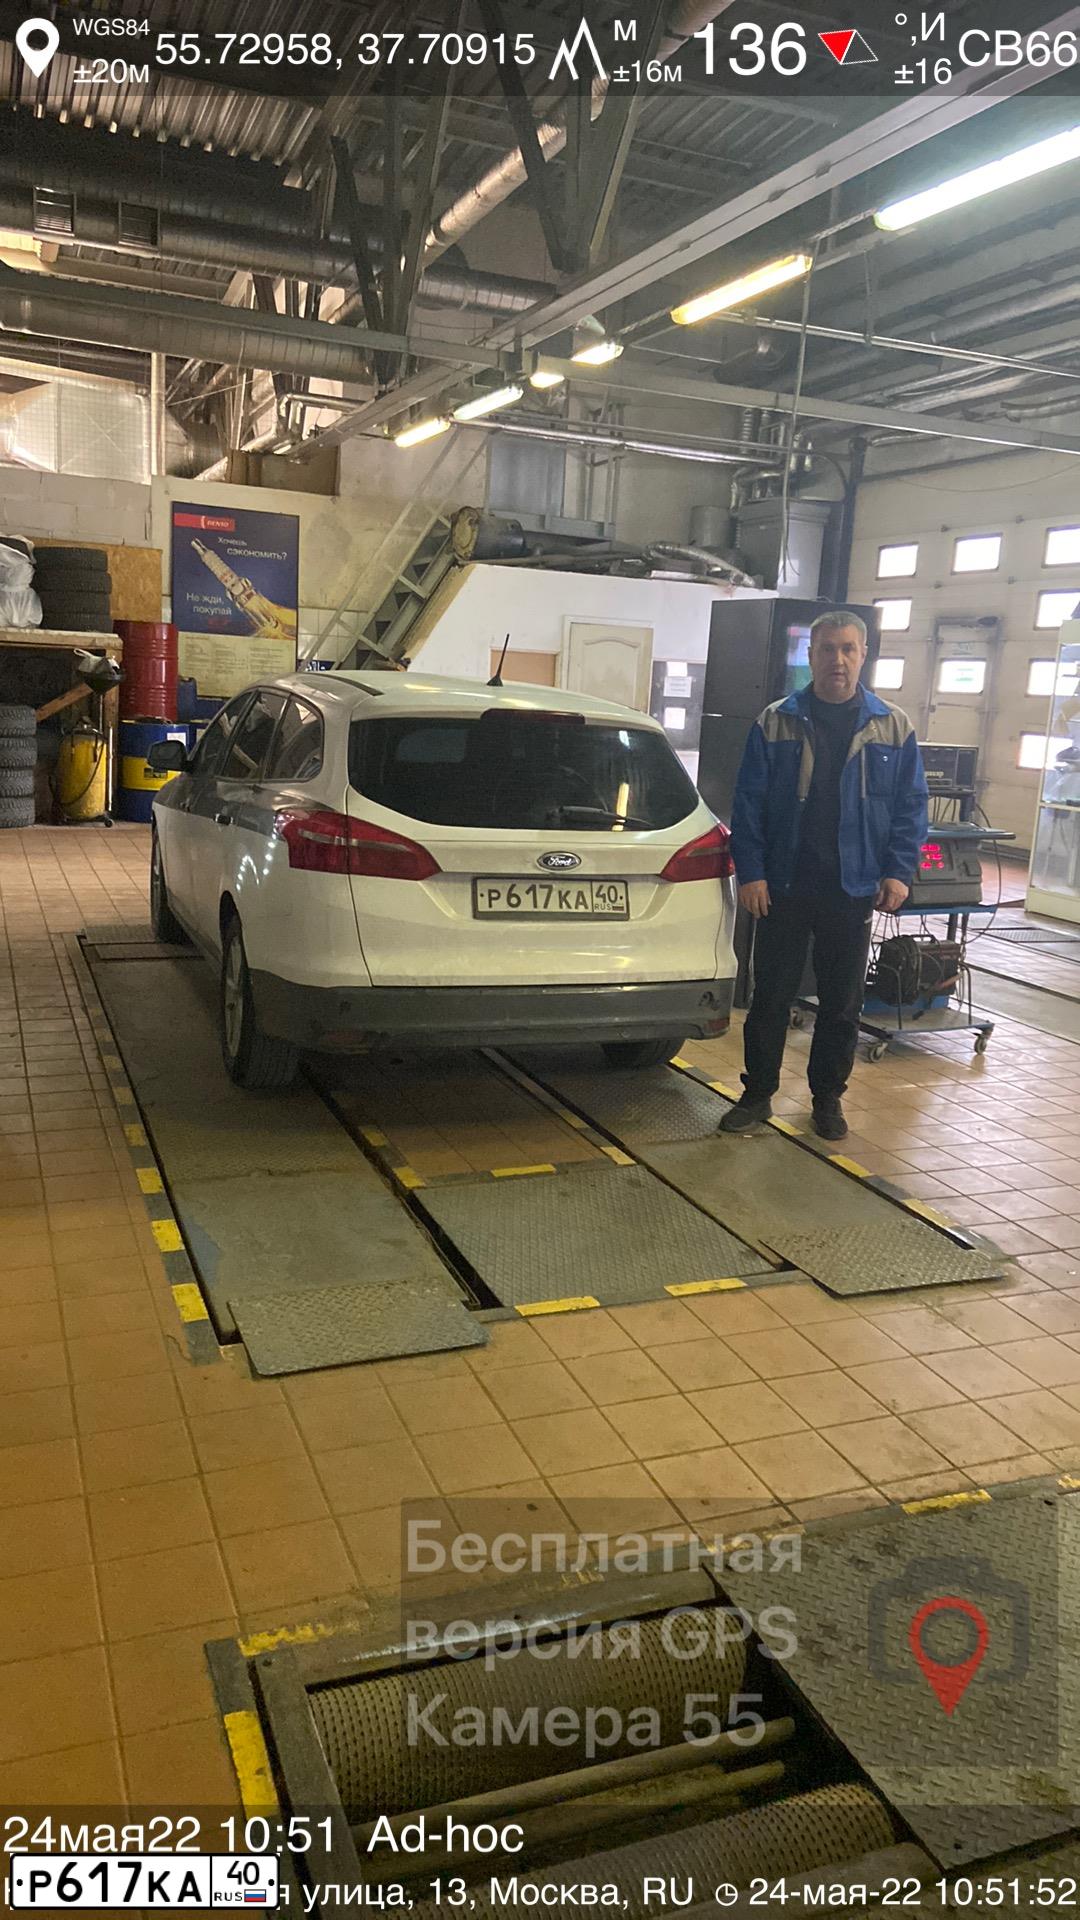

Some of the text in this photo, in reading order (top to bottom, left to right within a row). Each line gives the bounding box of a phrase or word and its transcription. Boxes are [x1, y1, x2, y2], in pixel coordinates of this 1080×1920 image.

[226, 547, 288, 560] сэкономить?
[193, 605, 233, 616] покупай
[548, 855, 574, 867] Ford
[594, 884, 619, 904] 40
[594, 902, 613, 912] RUS
